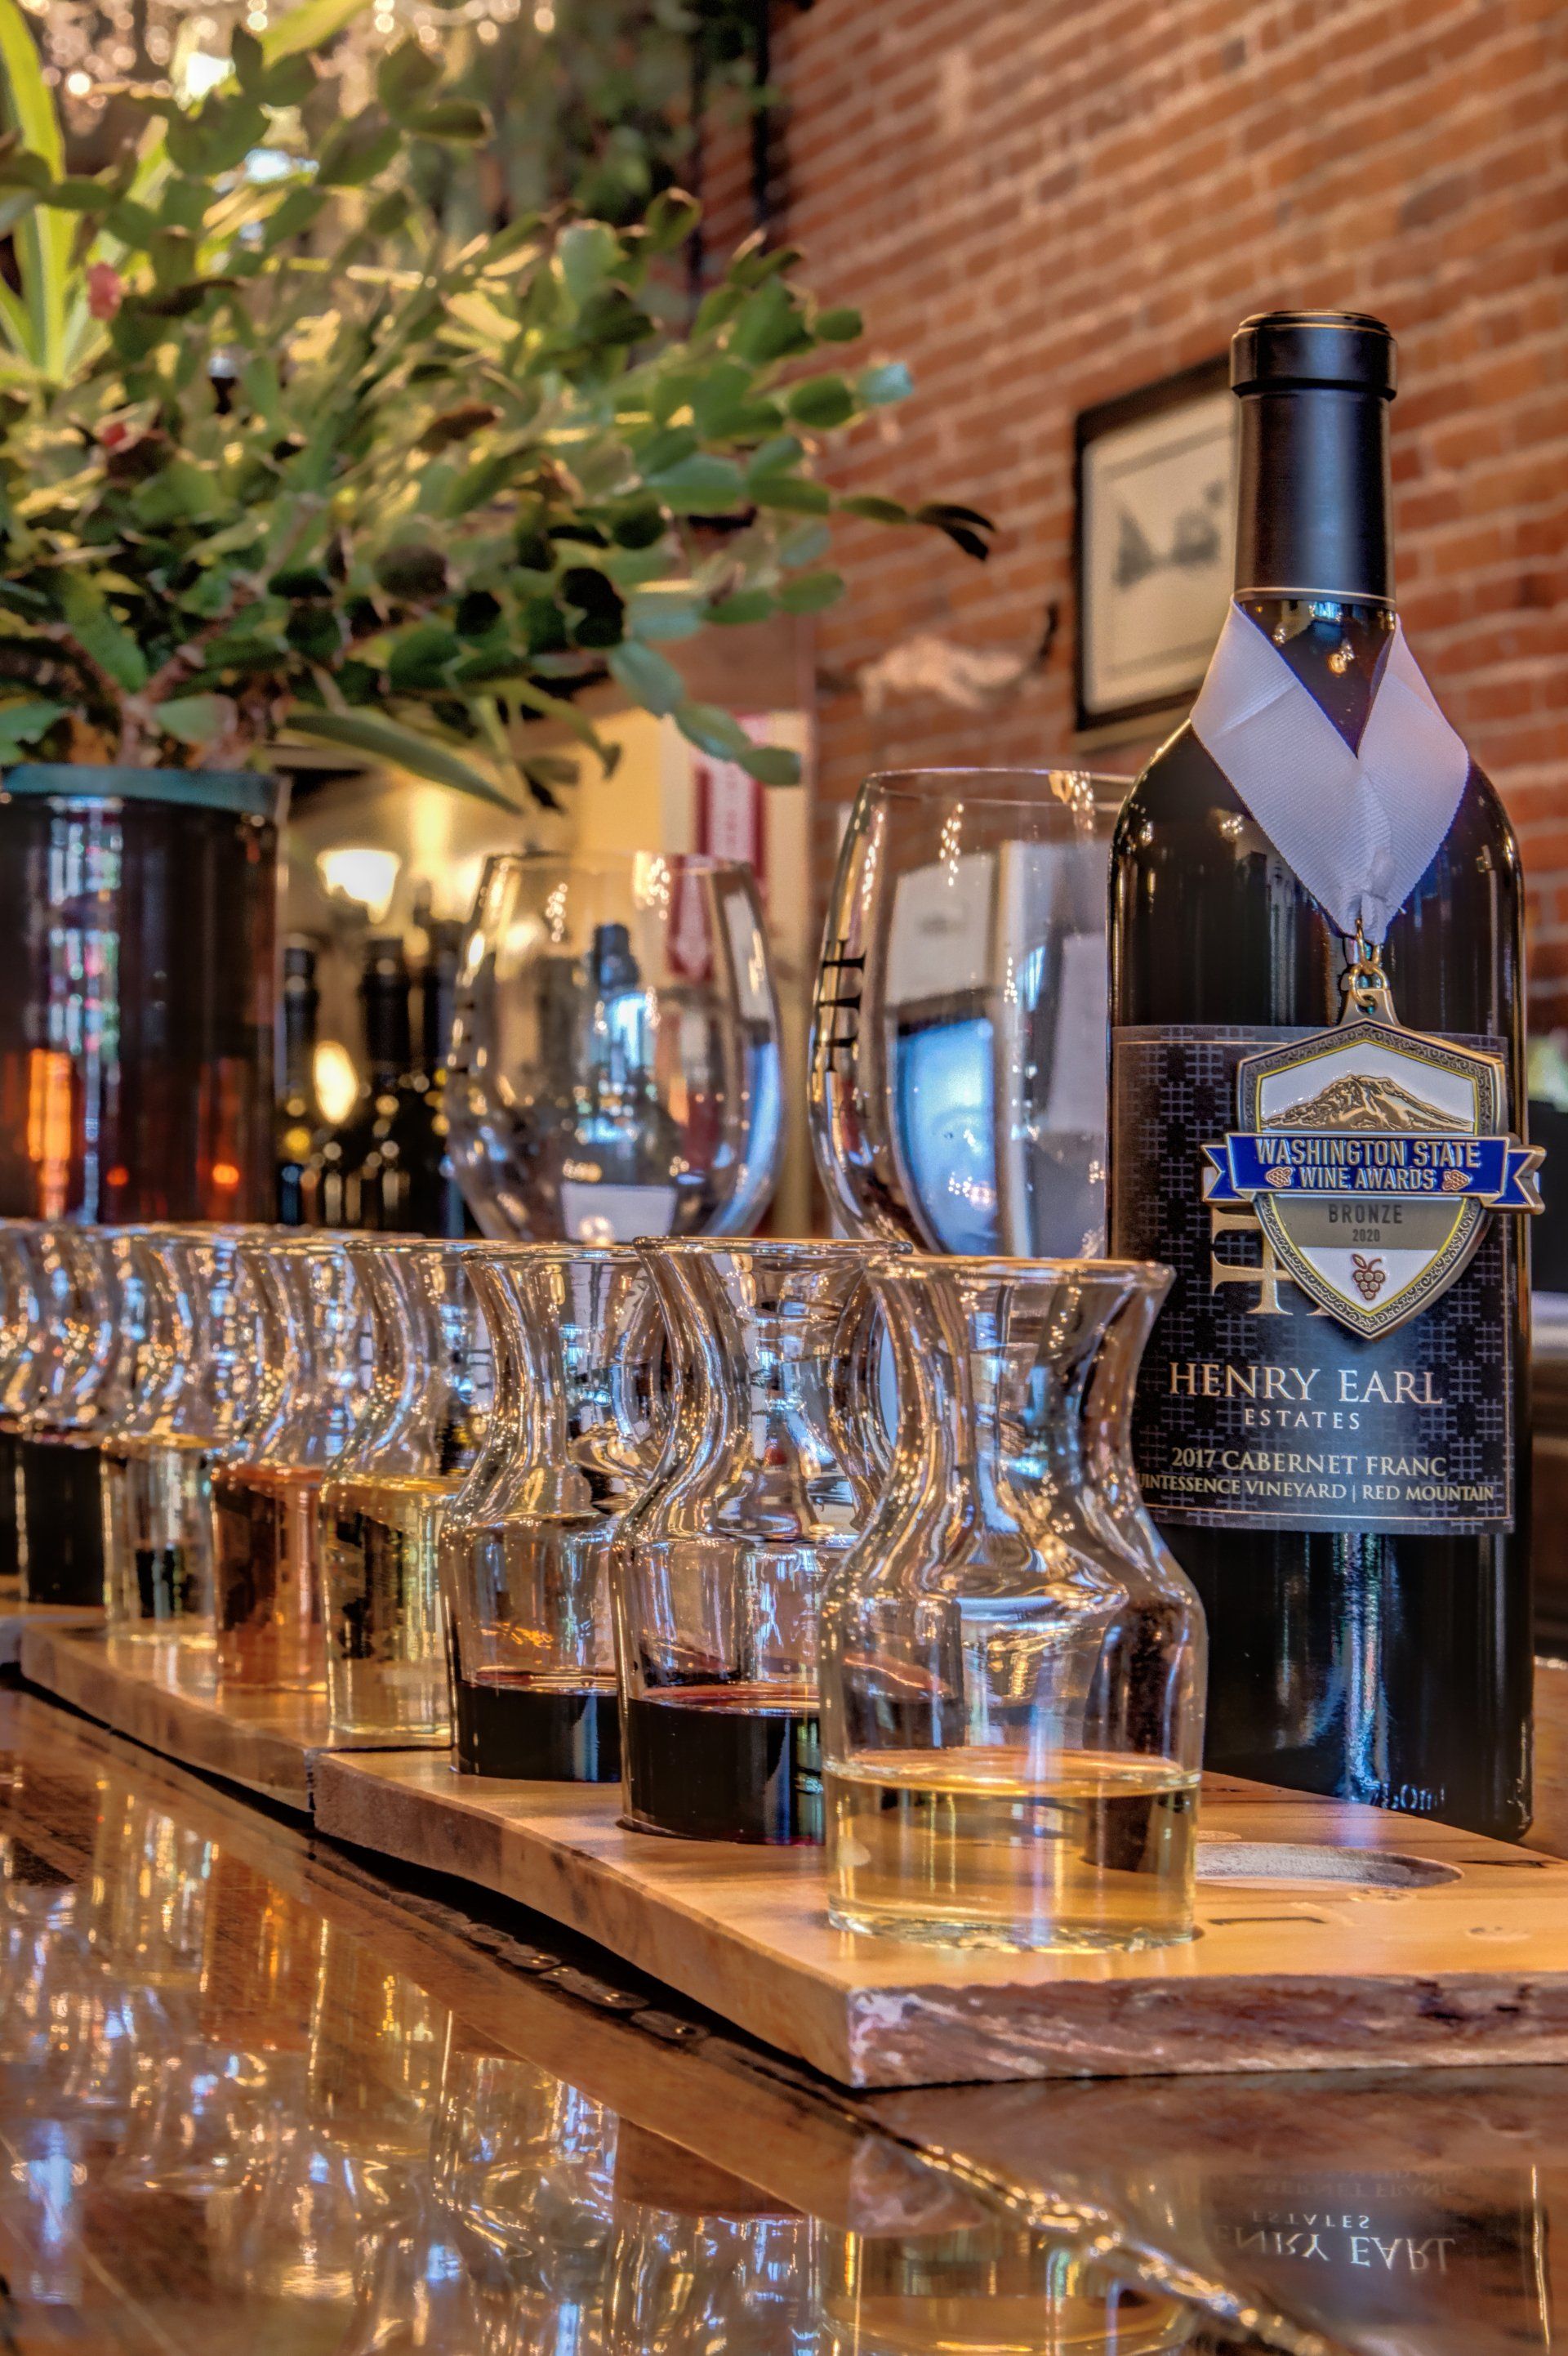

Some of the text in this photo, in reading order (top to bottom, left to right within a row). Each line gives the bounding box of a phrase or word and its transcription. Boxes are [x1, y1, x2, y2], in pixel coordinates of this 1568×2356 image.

[1255, 1139, 1480, 1169] WASHINGTON STATE
[1299, 1167, 1435, 1190] WINE AWARDS
[1329, 1203, 1403, 1225] BRONZE
[1352, 1229, 1380, 1243] 2020
[1169, 1362, 1443, 1405] HENRY EARL
[1245, 1408, 1360, 1430] ESTATES
[1171, 1448, 1447, 1478] 2017 CABERNET FRANC
[1136, 1473, 1494, 1502] UINTESSENCE VINEYARD RED MOUNTAIN
